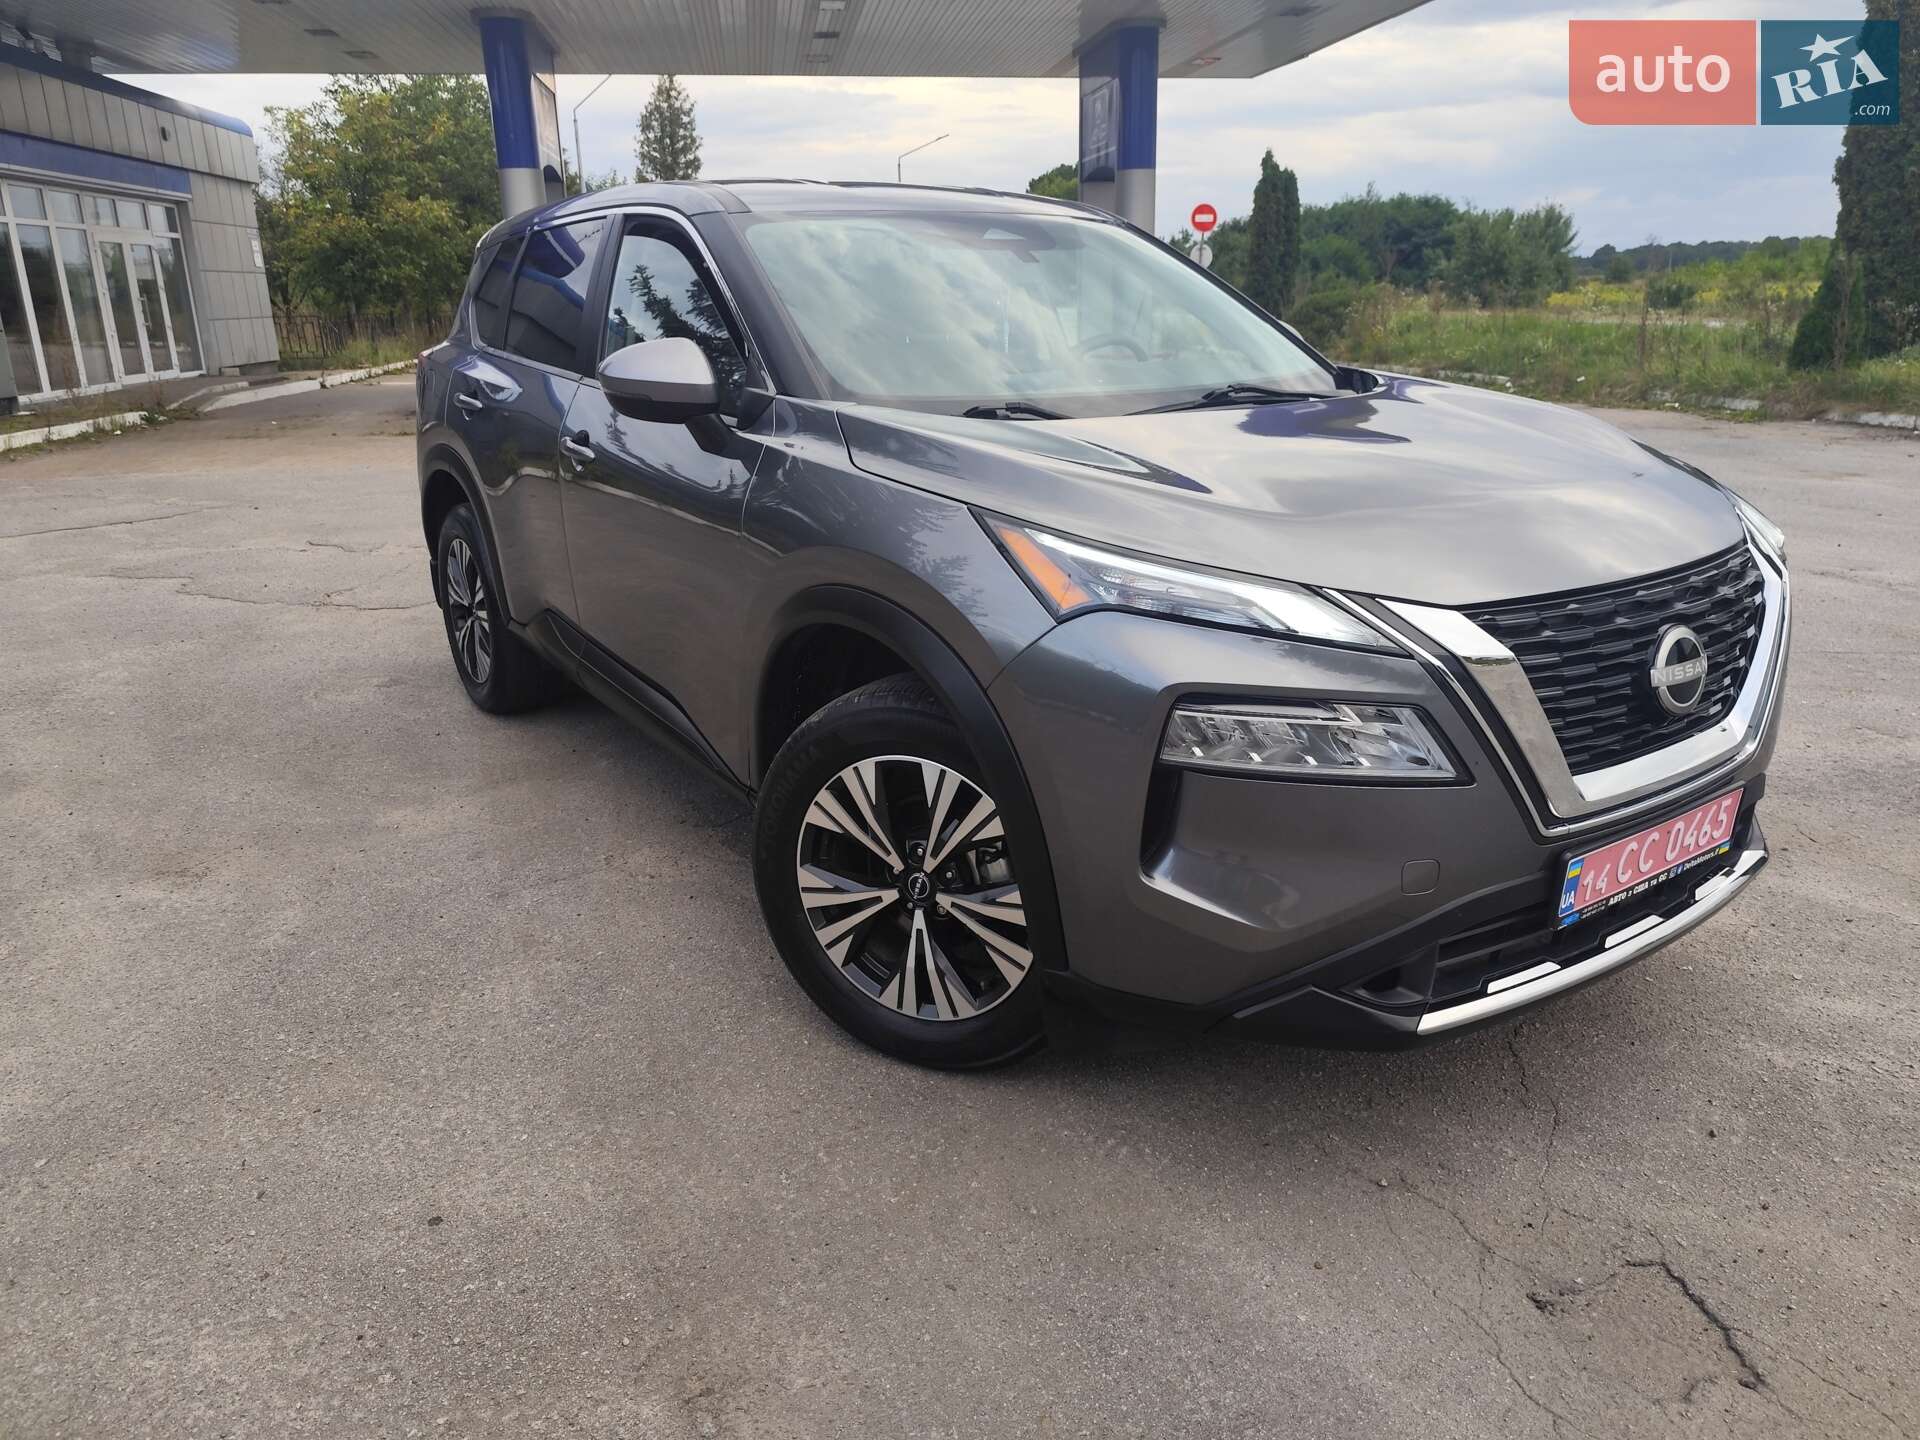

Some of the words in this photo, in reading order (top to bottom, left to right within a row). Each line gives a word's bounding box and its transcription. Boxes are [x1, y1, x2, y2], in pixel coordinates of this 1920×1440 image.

[1617, 831, 1660, 884] CC
[1665, 799, 1733, 862] 0465
[1560, 890, 1575, 909] UA
